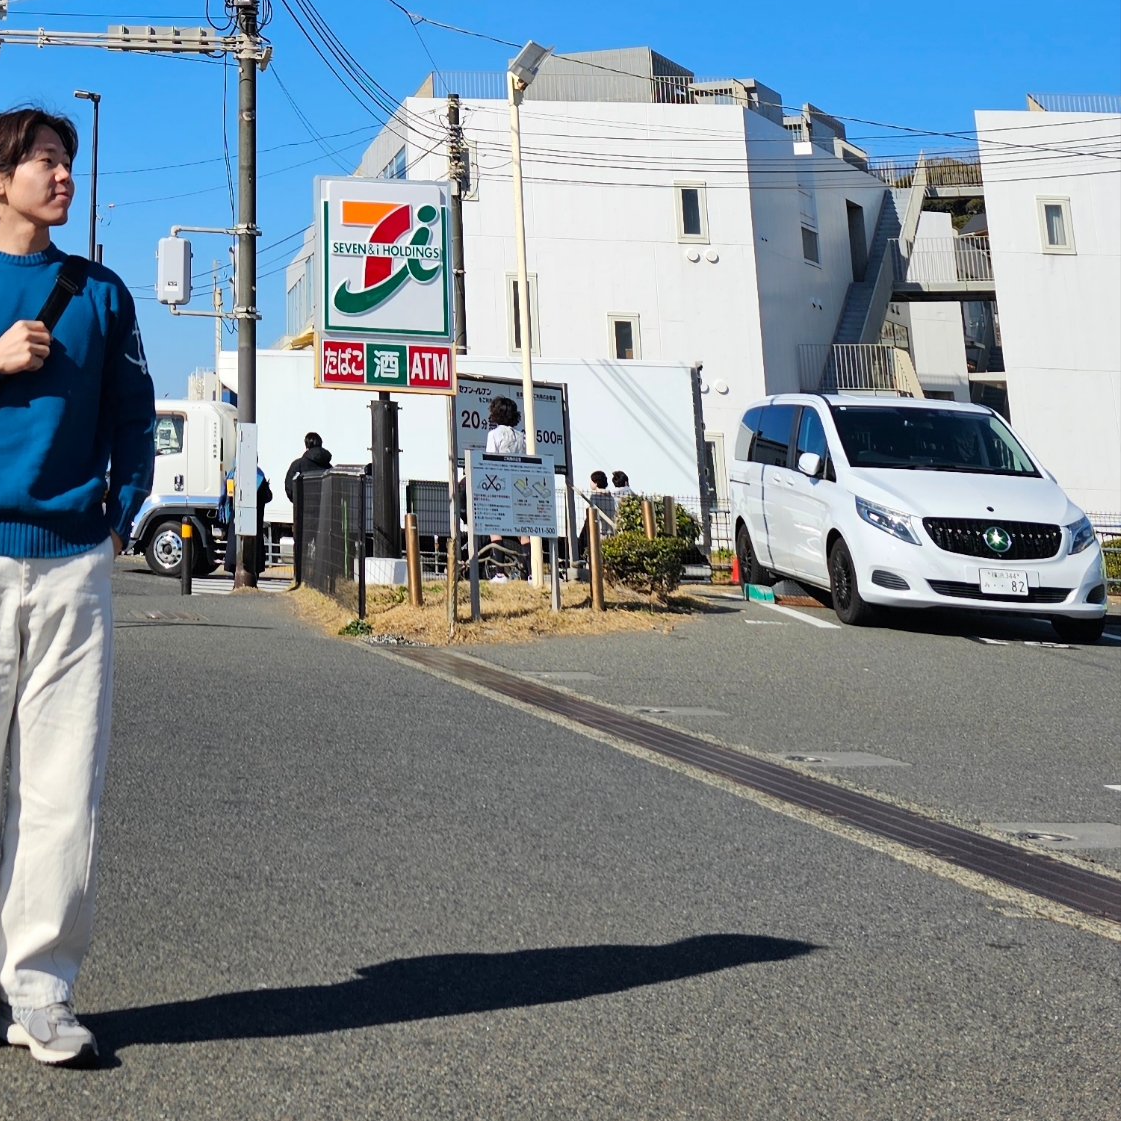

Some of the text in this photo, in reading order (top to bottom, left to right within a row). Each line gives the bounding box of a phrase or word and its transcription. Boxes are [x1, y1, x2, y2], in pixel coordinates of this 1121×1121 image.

[383, 245, 440, 259] HOLDINGS
[325, 347, 364, 376] たばこ
[373, 350, 400, 378] 酒
[411, 352, 449, 380] ATM
[1011, 581, 1025, 593] 82
